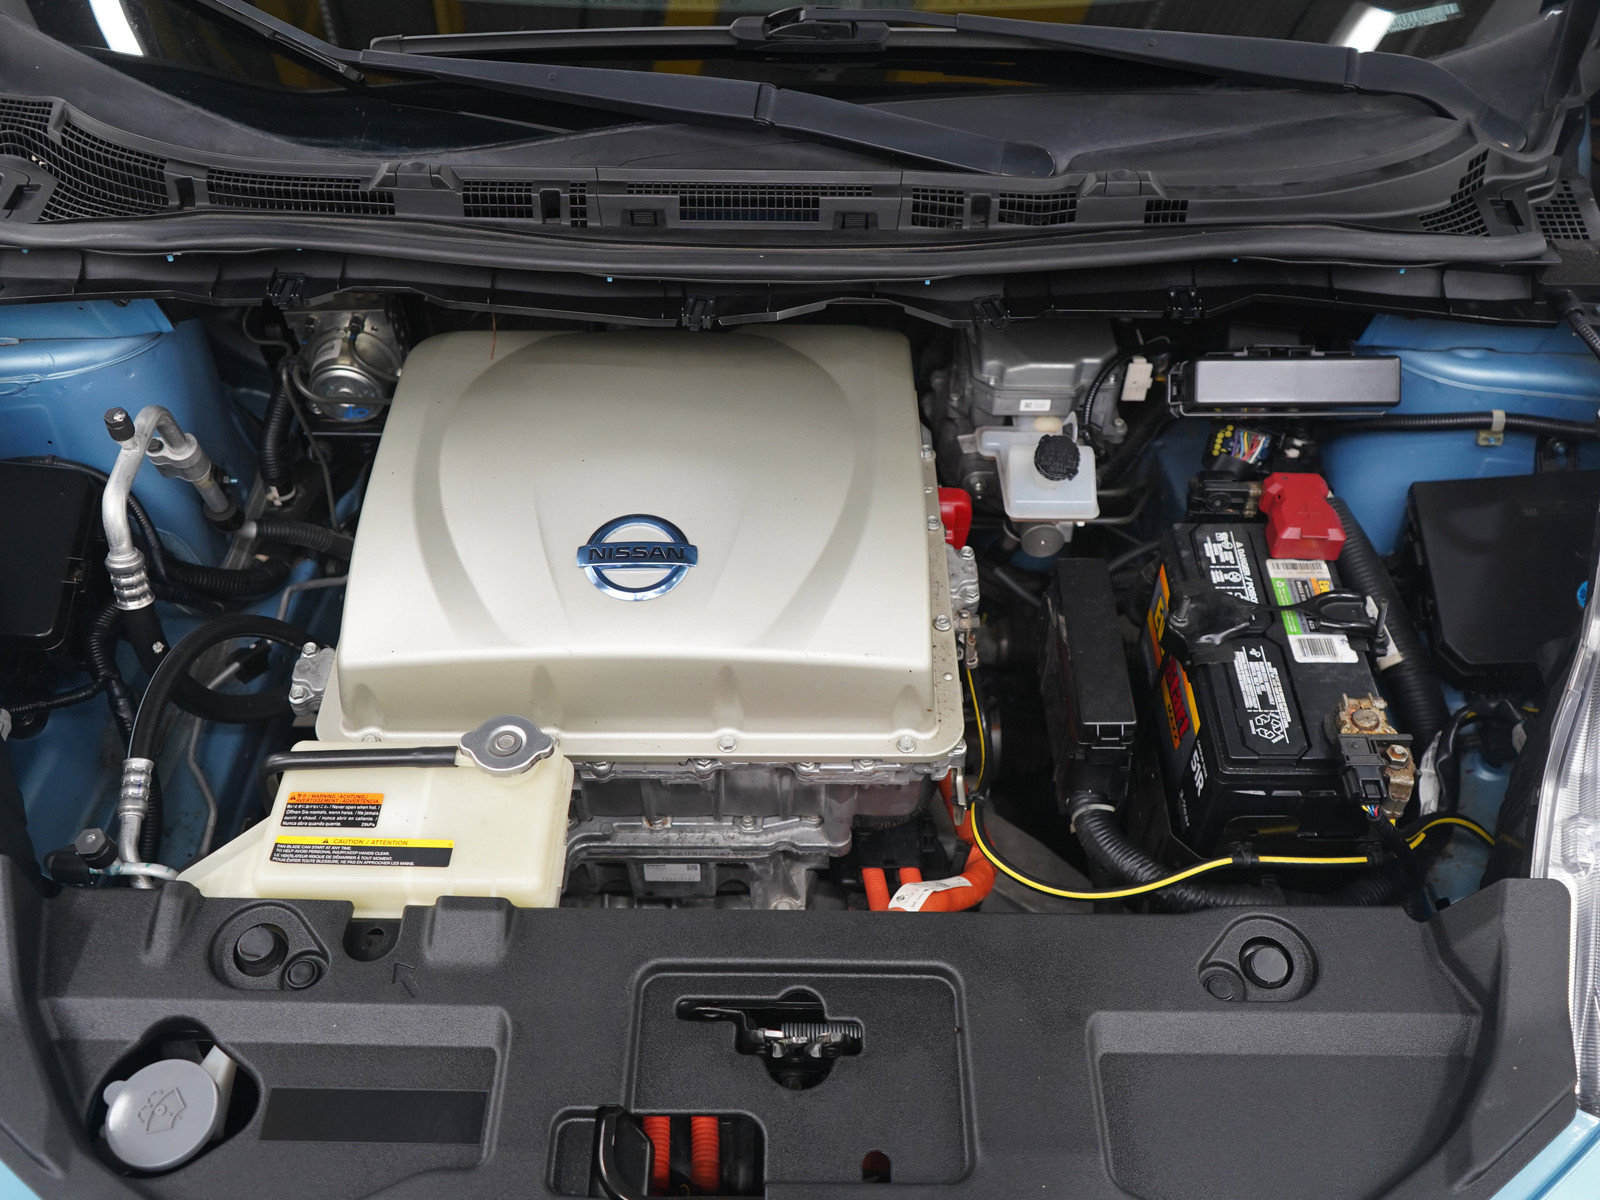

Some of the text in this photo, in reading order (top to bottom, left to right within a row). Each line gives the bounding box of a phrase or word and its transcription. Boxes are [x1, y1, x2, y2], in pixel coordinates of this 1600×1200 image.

[588, 546, 684, 560] NISSAN
[1238, 548, 1250, 576] DANGER
[1246, 582, 1258, 604] POISO
[1190, 749, 1204, 797] 51R
